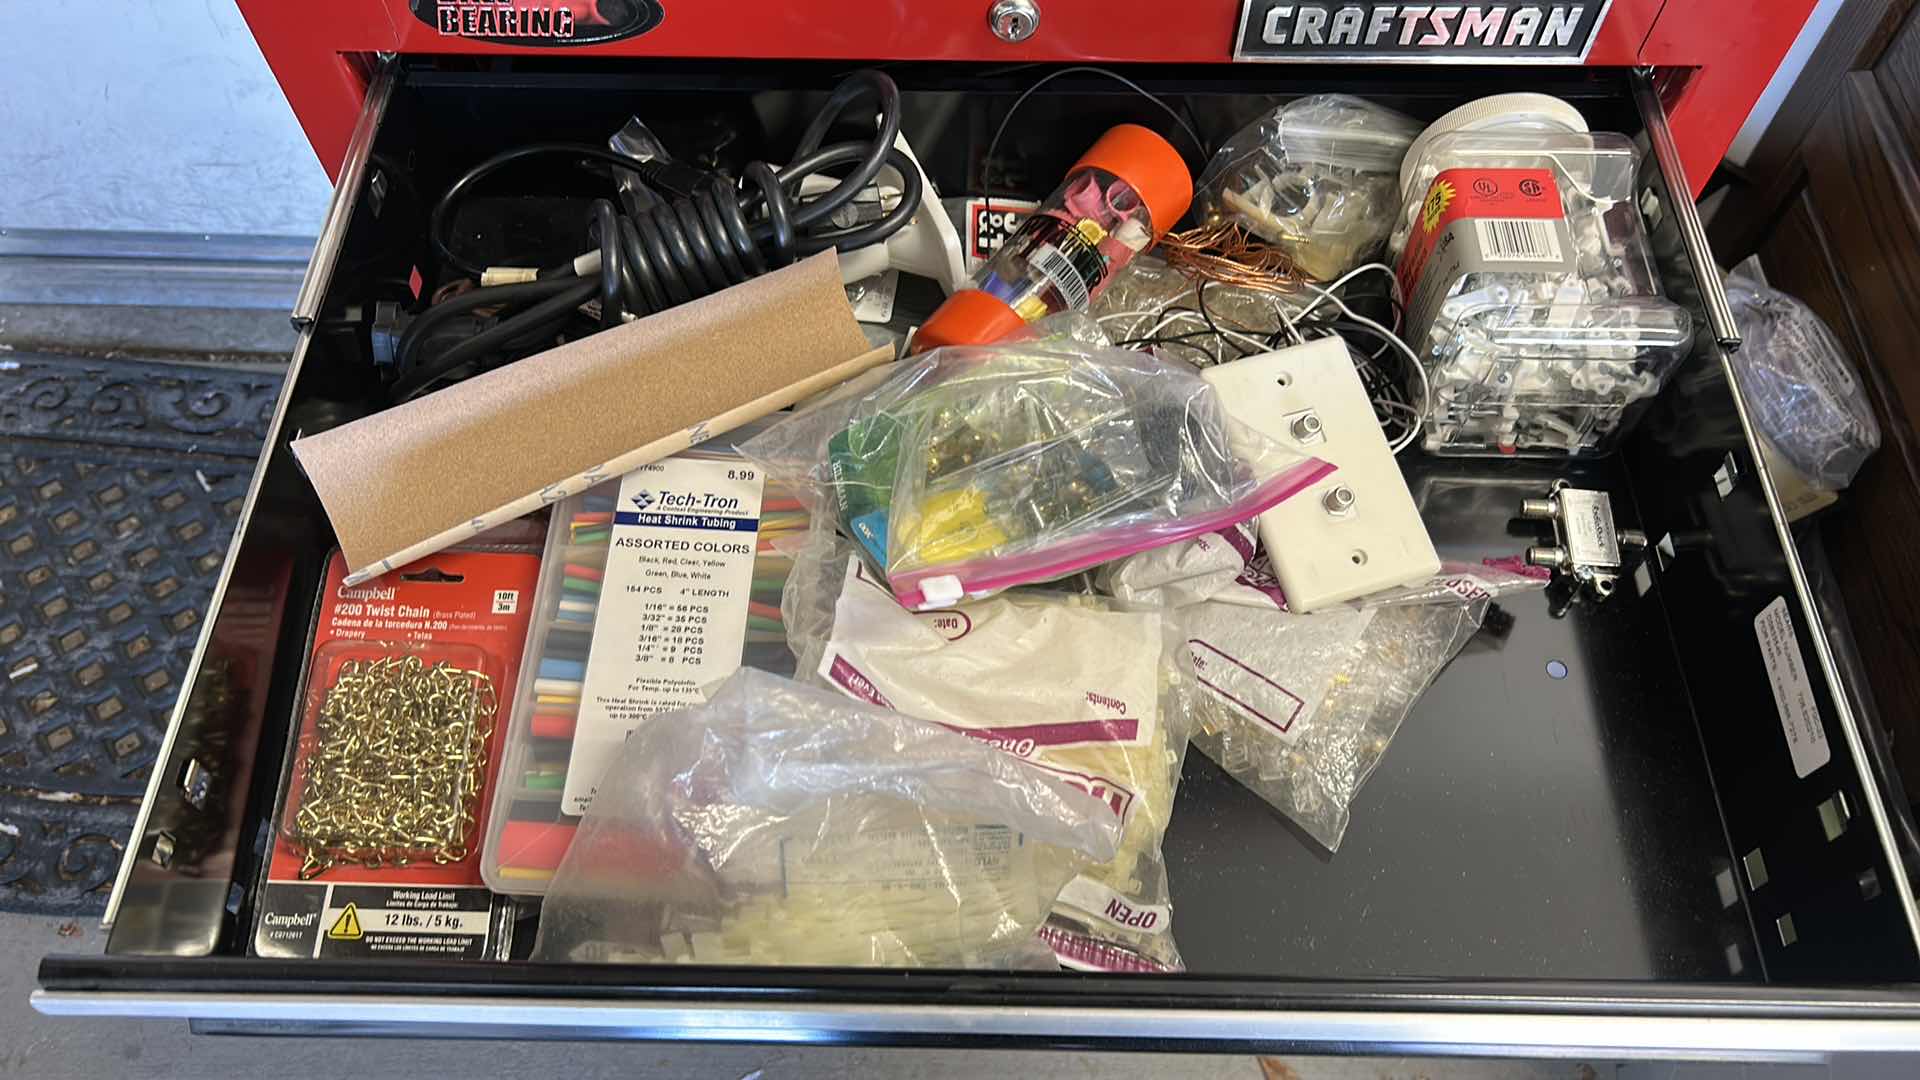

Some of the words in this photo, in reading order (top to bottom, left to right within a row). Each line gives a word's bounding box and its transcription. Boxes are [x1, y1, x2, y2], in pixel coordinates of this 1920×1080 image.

[437, 5, 575, 37] BEARING
[1262, 6, 1584, 46] CRAFTSMAN
[727, 469, 755, 481] 8.99
[659, 490, 739, 510] Tech-Tron
[723, 508, 749, 516] Product
[638, 513, 662, 525] Heat
[664, 514, 699, 527] Shrink
[701, 516, 737, 530] Tubing
[615, 537, 690, 551] ASSORTED
[693, 541, 751, 555] COLORS
[703, 559, 726, 567] Yellow
[645, 569, 669, 578] Green,
[671, 570, 689, 579] Blue,
[690, 571, 711, 580] White
[337, 586, 396, 602] Campbell
[497, 592, 514, 600] 10ft
[643, 586, 663, 594] PCS
[692, 588, 730, 597] LENGTH
[334, 603, 363, 617] #200
[366, 604, 395, 617] Twist
[398, 605, 430, 618] Chain
[497, 603, 511, 611] 3m
[689, 605, 709, 614] PCS
[331, 617, 361, 628] Cadena
[362, 618, 374, 628] de
[374, 619, 383, 628] la
[384, 619, 423, 630] torcedura
[688, 616, 708, 624] PCS
[335, 628, 366, 639] Drapery
[413, 631, 433, 640] Telas
[684, 626, 704, 634] PCS
[685, 636, 705, 645] PCS
[684, 646, 703, 655] PCS
[682, 656, 702, 665] PCS
[1085, 690, 1127, 715] Contents:
[392, 890, 420, 901] Working
[421, 891, 439, 900] Load
[438, 891, 455, 901] Limit
[1104, 898, 1157, 929] OPEN
[264, 911, 313, 929] Campbell
[385, 913, 399, 926] 12
[401, 913, 423, 927] lbs.
[425, 914, 433, 928] /
[434, 914, 442, 927] 5
[445, 915, 463, 929] kg.
